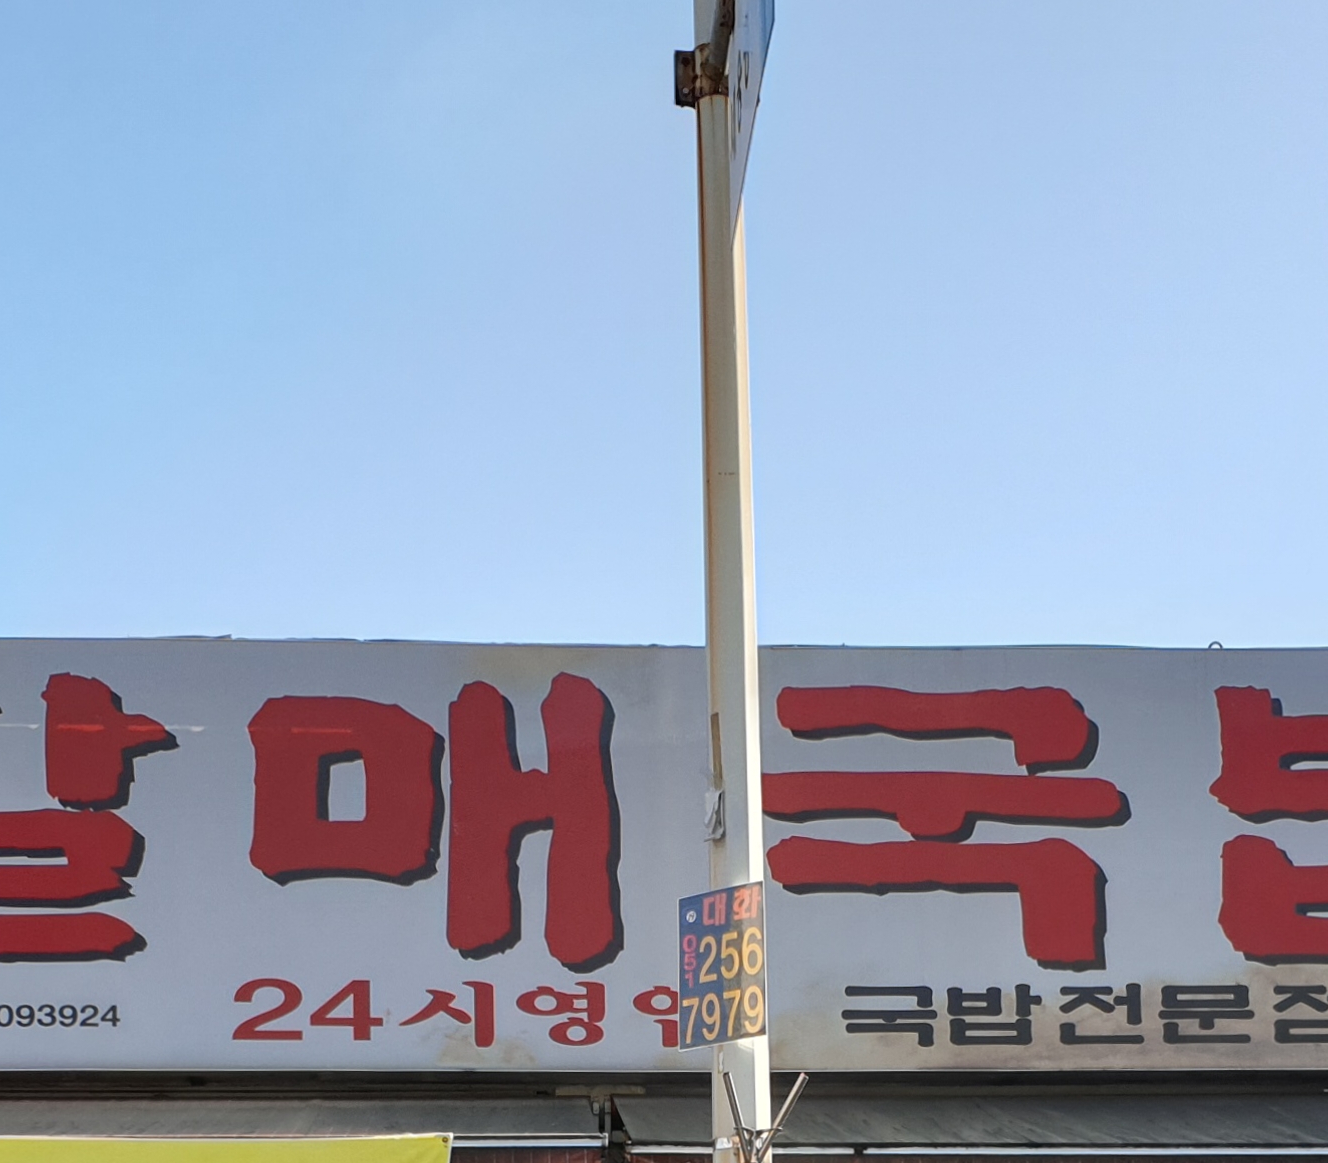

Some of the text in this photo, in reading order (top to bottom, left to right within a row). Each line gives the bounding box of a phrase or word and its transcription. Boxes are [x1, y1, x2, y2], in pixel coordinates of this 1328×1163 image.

[703, 884, 761, 927] 대화
[683, 934, 697, 989] 051
[699, 926, 763, 984] 256
[682, 985, 764, 1044] 7979
